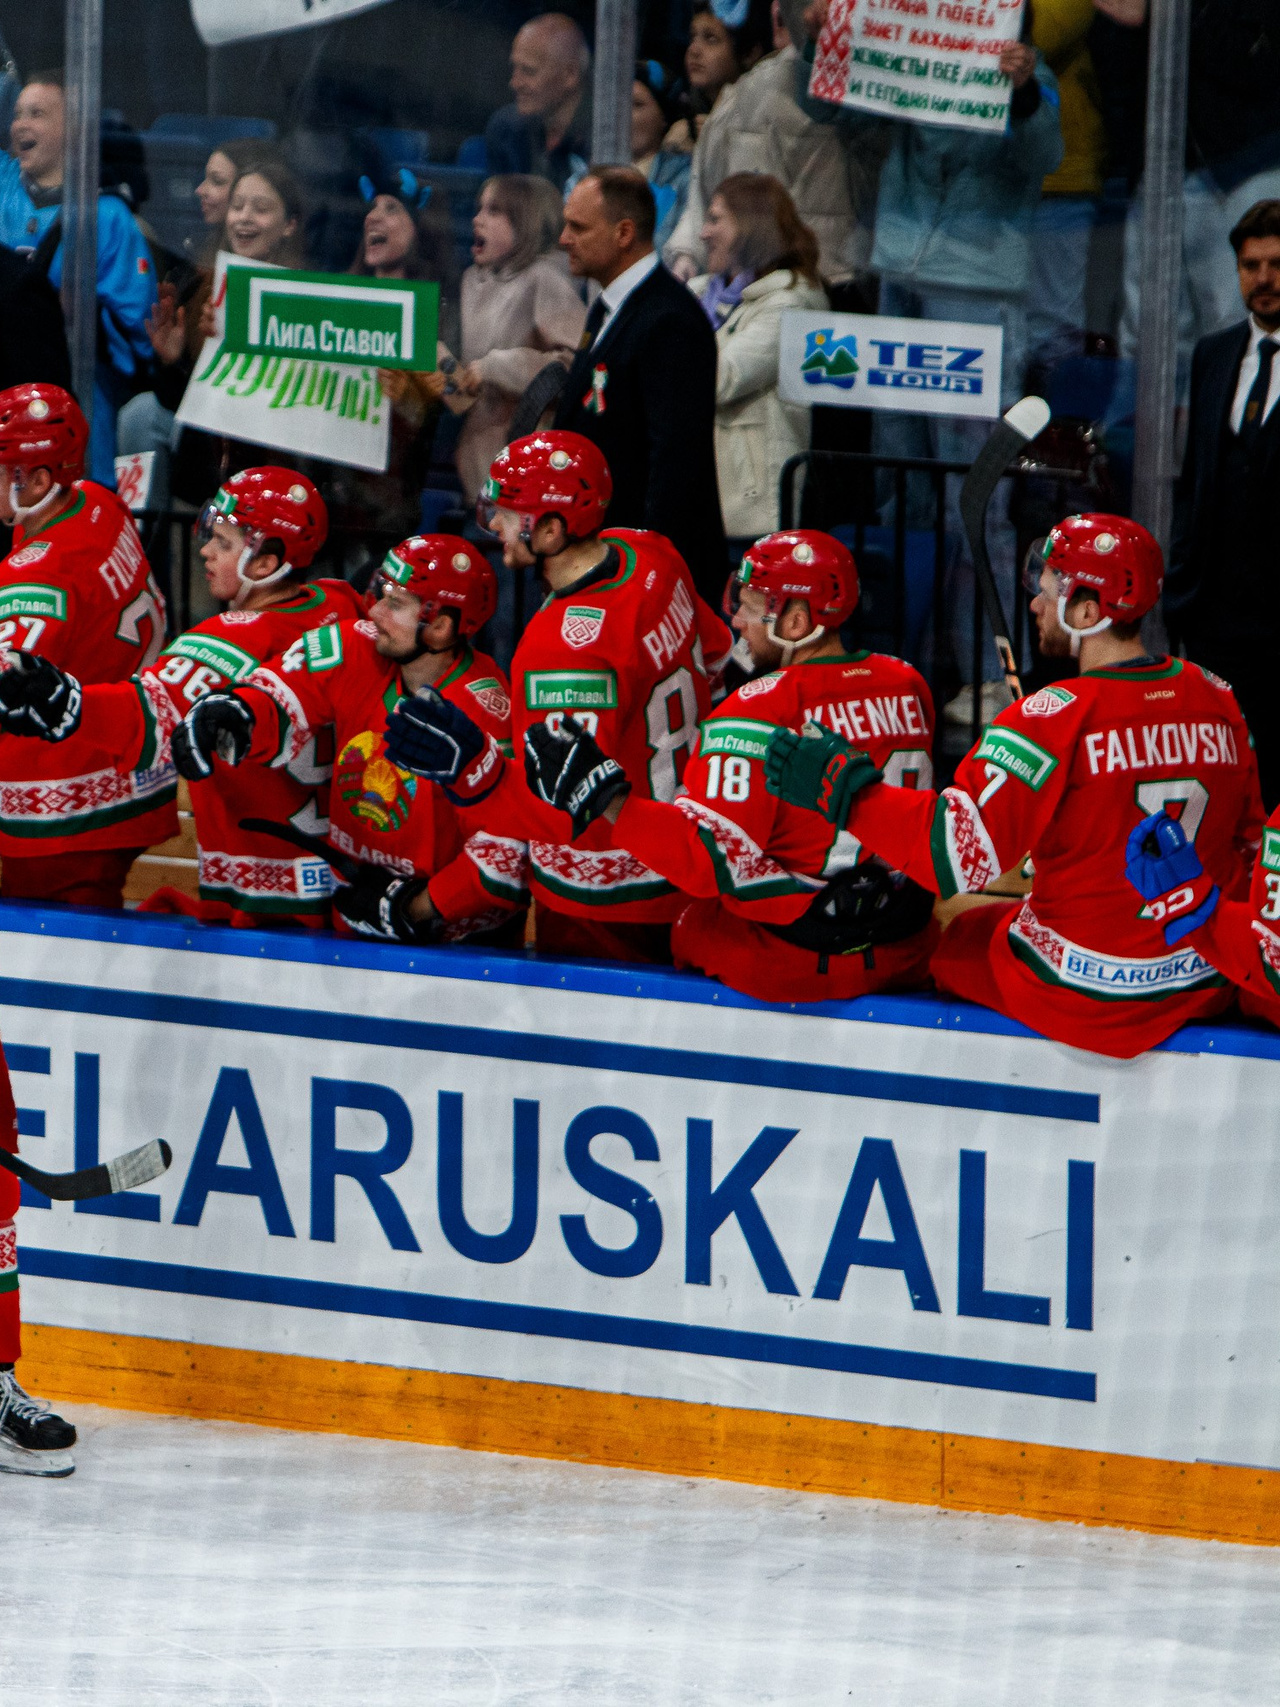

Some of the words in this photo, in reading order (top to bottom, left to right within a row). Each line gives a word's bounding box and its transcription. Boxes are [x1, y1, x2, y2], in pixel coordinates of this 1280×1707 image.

[869, 339, 985, 374] TEZ
[878, 370, 972, 390] TOUR
[271, 517, 303, 532] CCM
[781, 583, 812, 593] CCM
[1077, 570, 1106, 586] CCM
[437, 589, 467, 601] CCM
[157, 655, 222, 704] 96
[705, 754, 752, 803] 18
[977, 761, 1009, 810] 7
